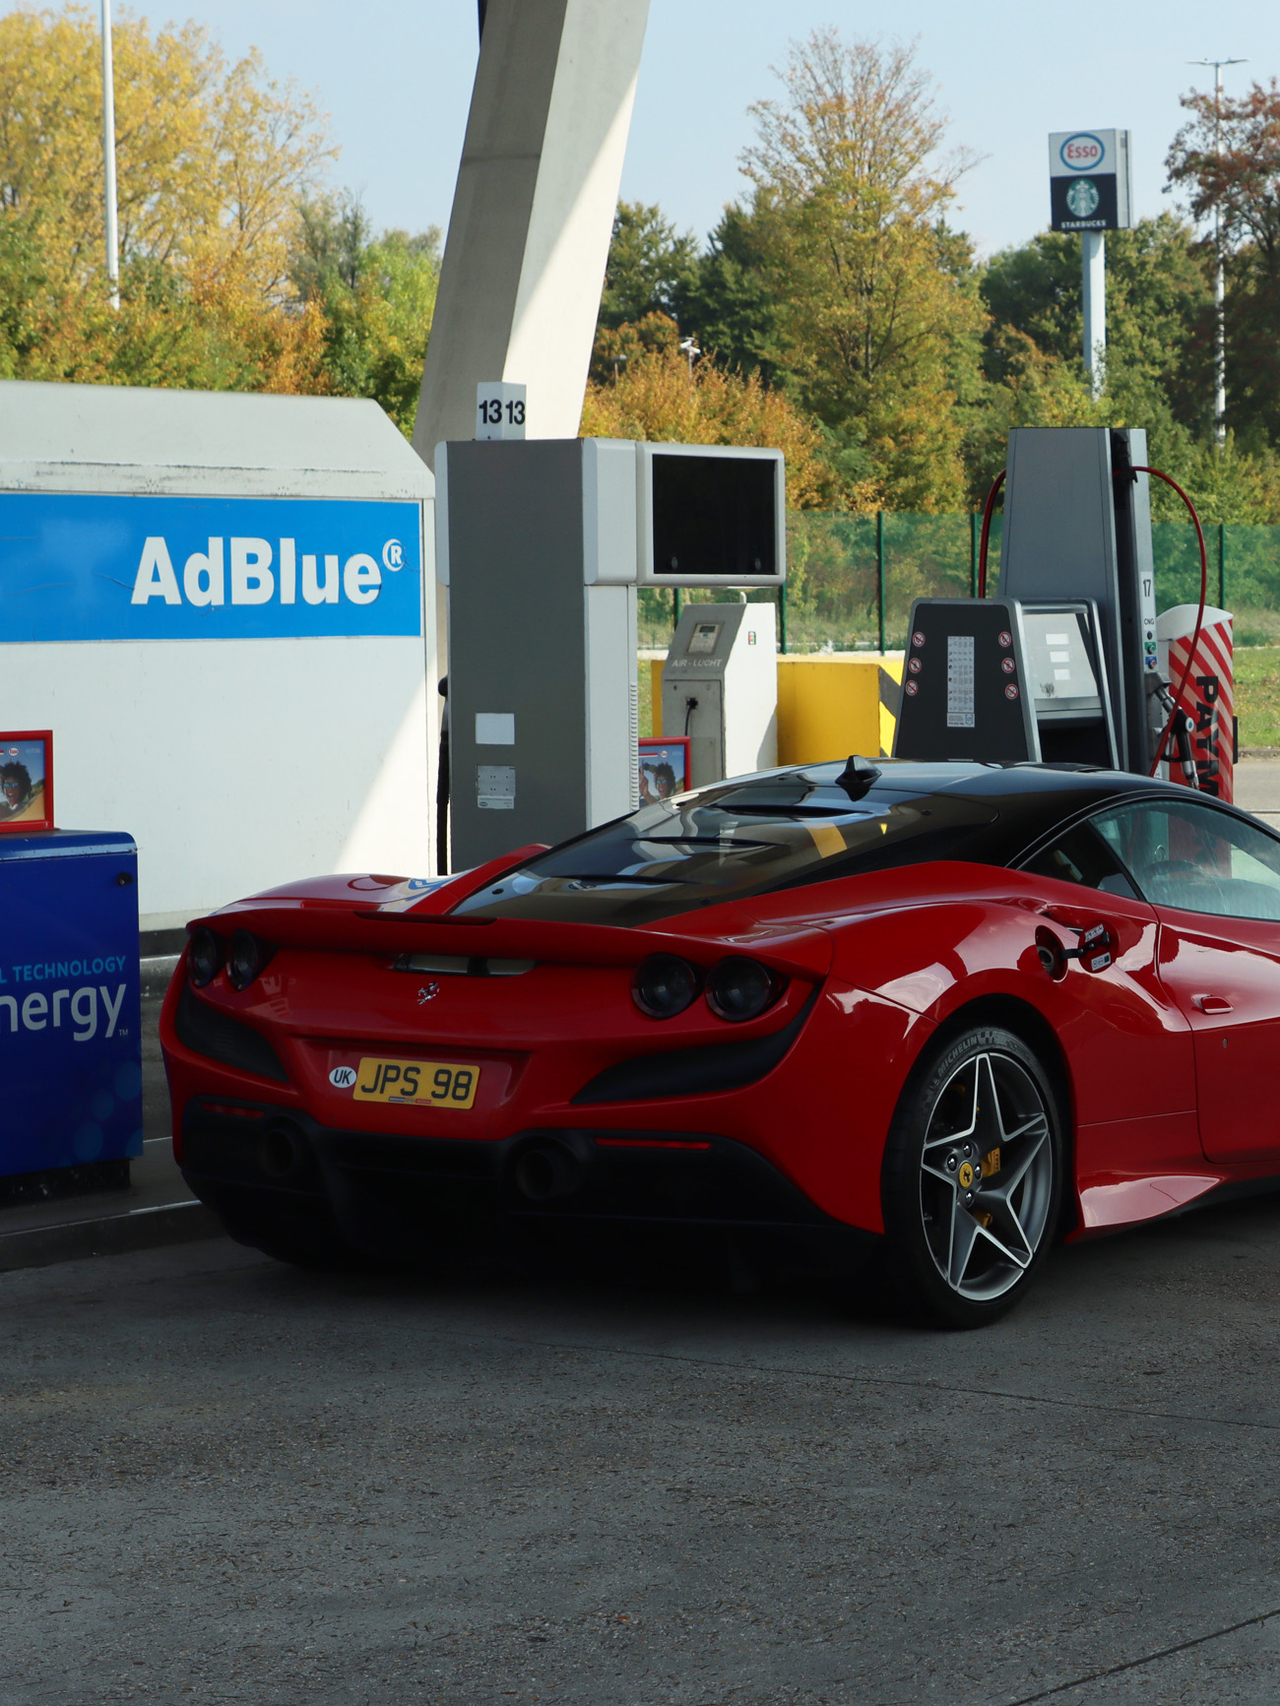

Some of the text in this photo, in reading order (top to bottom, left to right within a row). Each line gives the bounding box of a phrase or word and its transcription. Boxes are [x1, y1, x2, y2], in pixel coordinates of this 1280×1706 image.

[1061, 219, 1106, 229] STARBUCKS
[479, 399, 502, 424] 13
[505, 400, 526, 425] 13
[1143, 579, 1151, 597] 17
[693, 659, 722, 667] LUCHT
[12, 956, 126, 982] TECHNOLOGY
[937, 1034, 978, 1076] MICHELIN
[333, 1069, 352, 1085] UK
[361, 1064, 473, 1101] JPS 98
